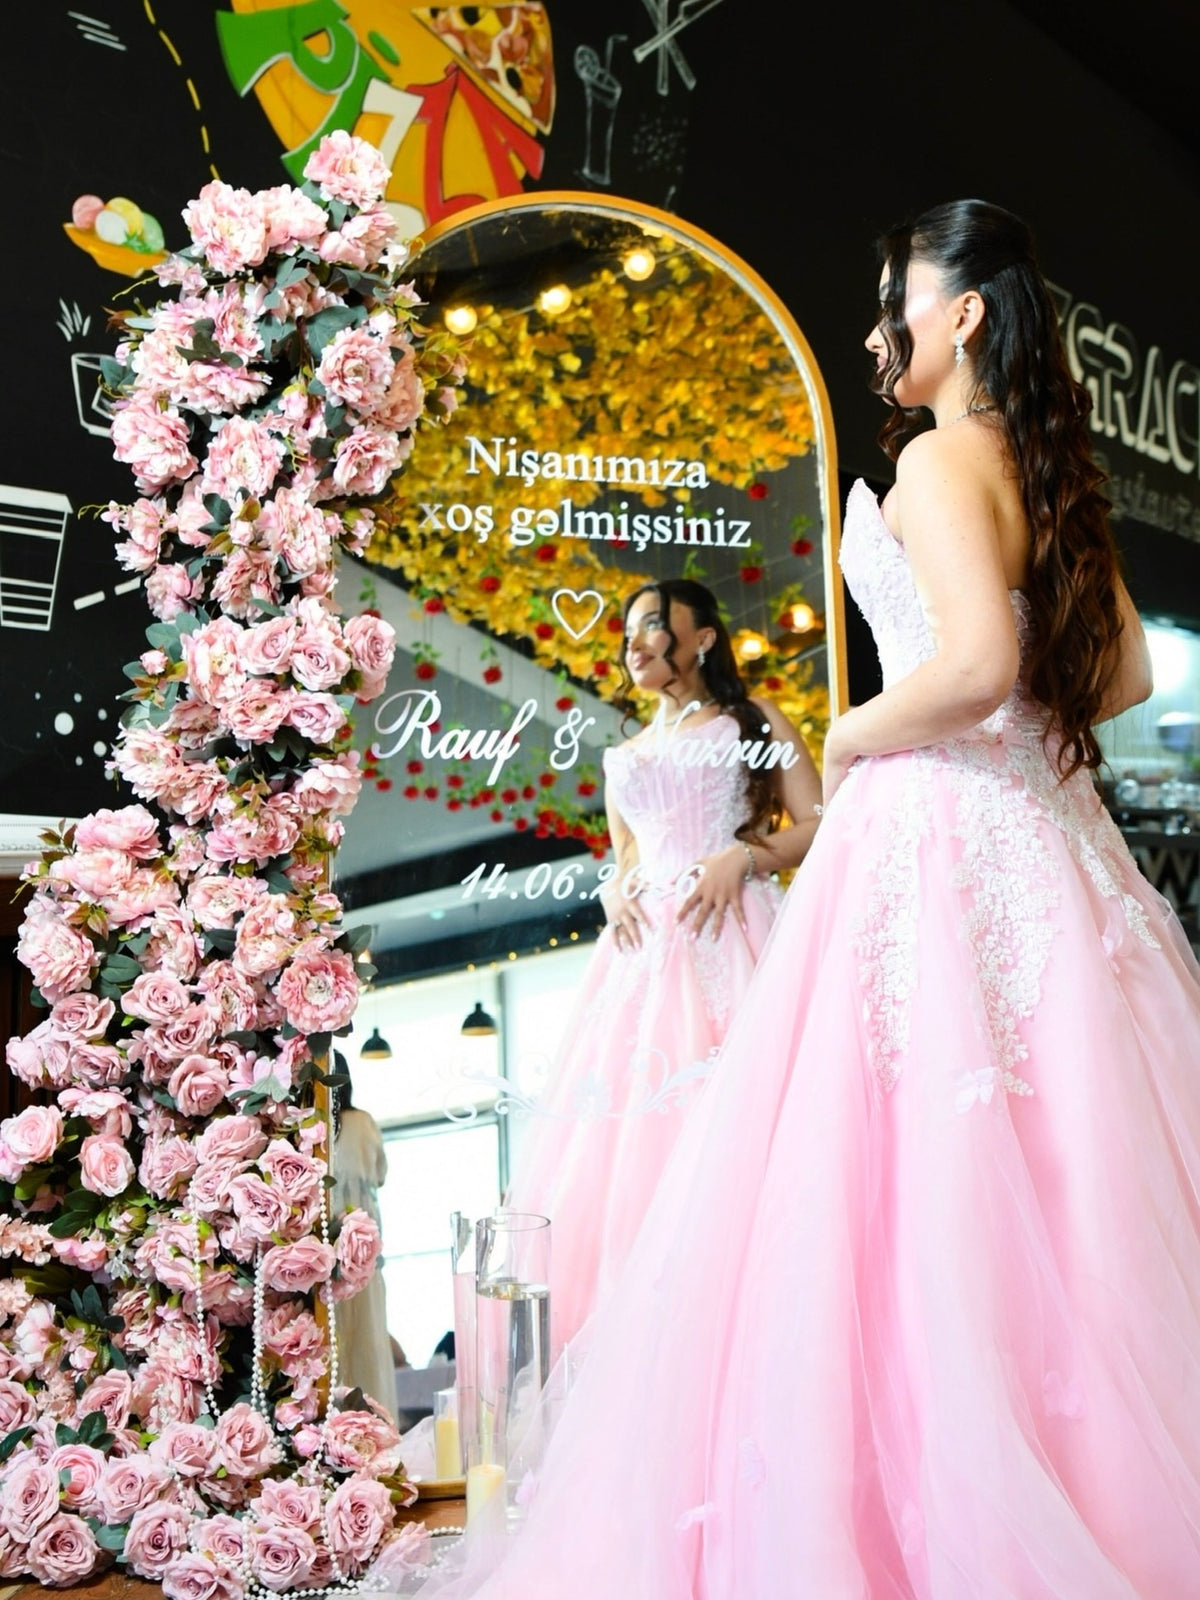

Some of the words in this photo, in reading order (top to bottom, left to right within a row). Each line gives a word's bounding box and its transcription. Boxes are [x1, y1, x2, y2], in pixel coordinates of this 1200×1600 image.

[464, 435, 710, 490] Nişanımıza
[417, 502, 495, 544] xoş
[508, 498, 752, 552] gəlmişsiniz
[371, 688, 538, 787] Rauf
[549, 707, 597, 771] &
[459, 861, 707, 901] 14.06.206
